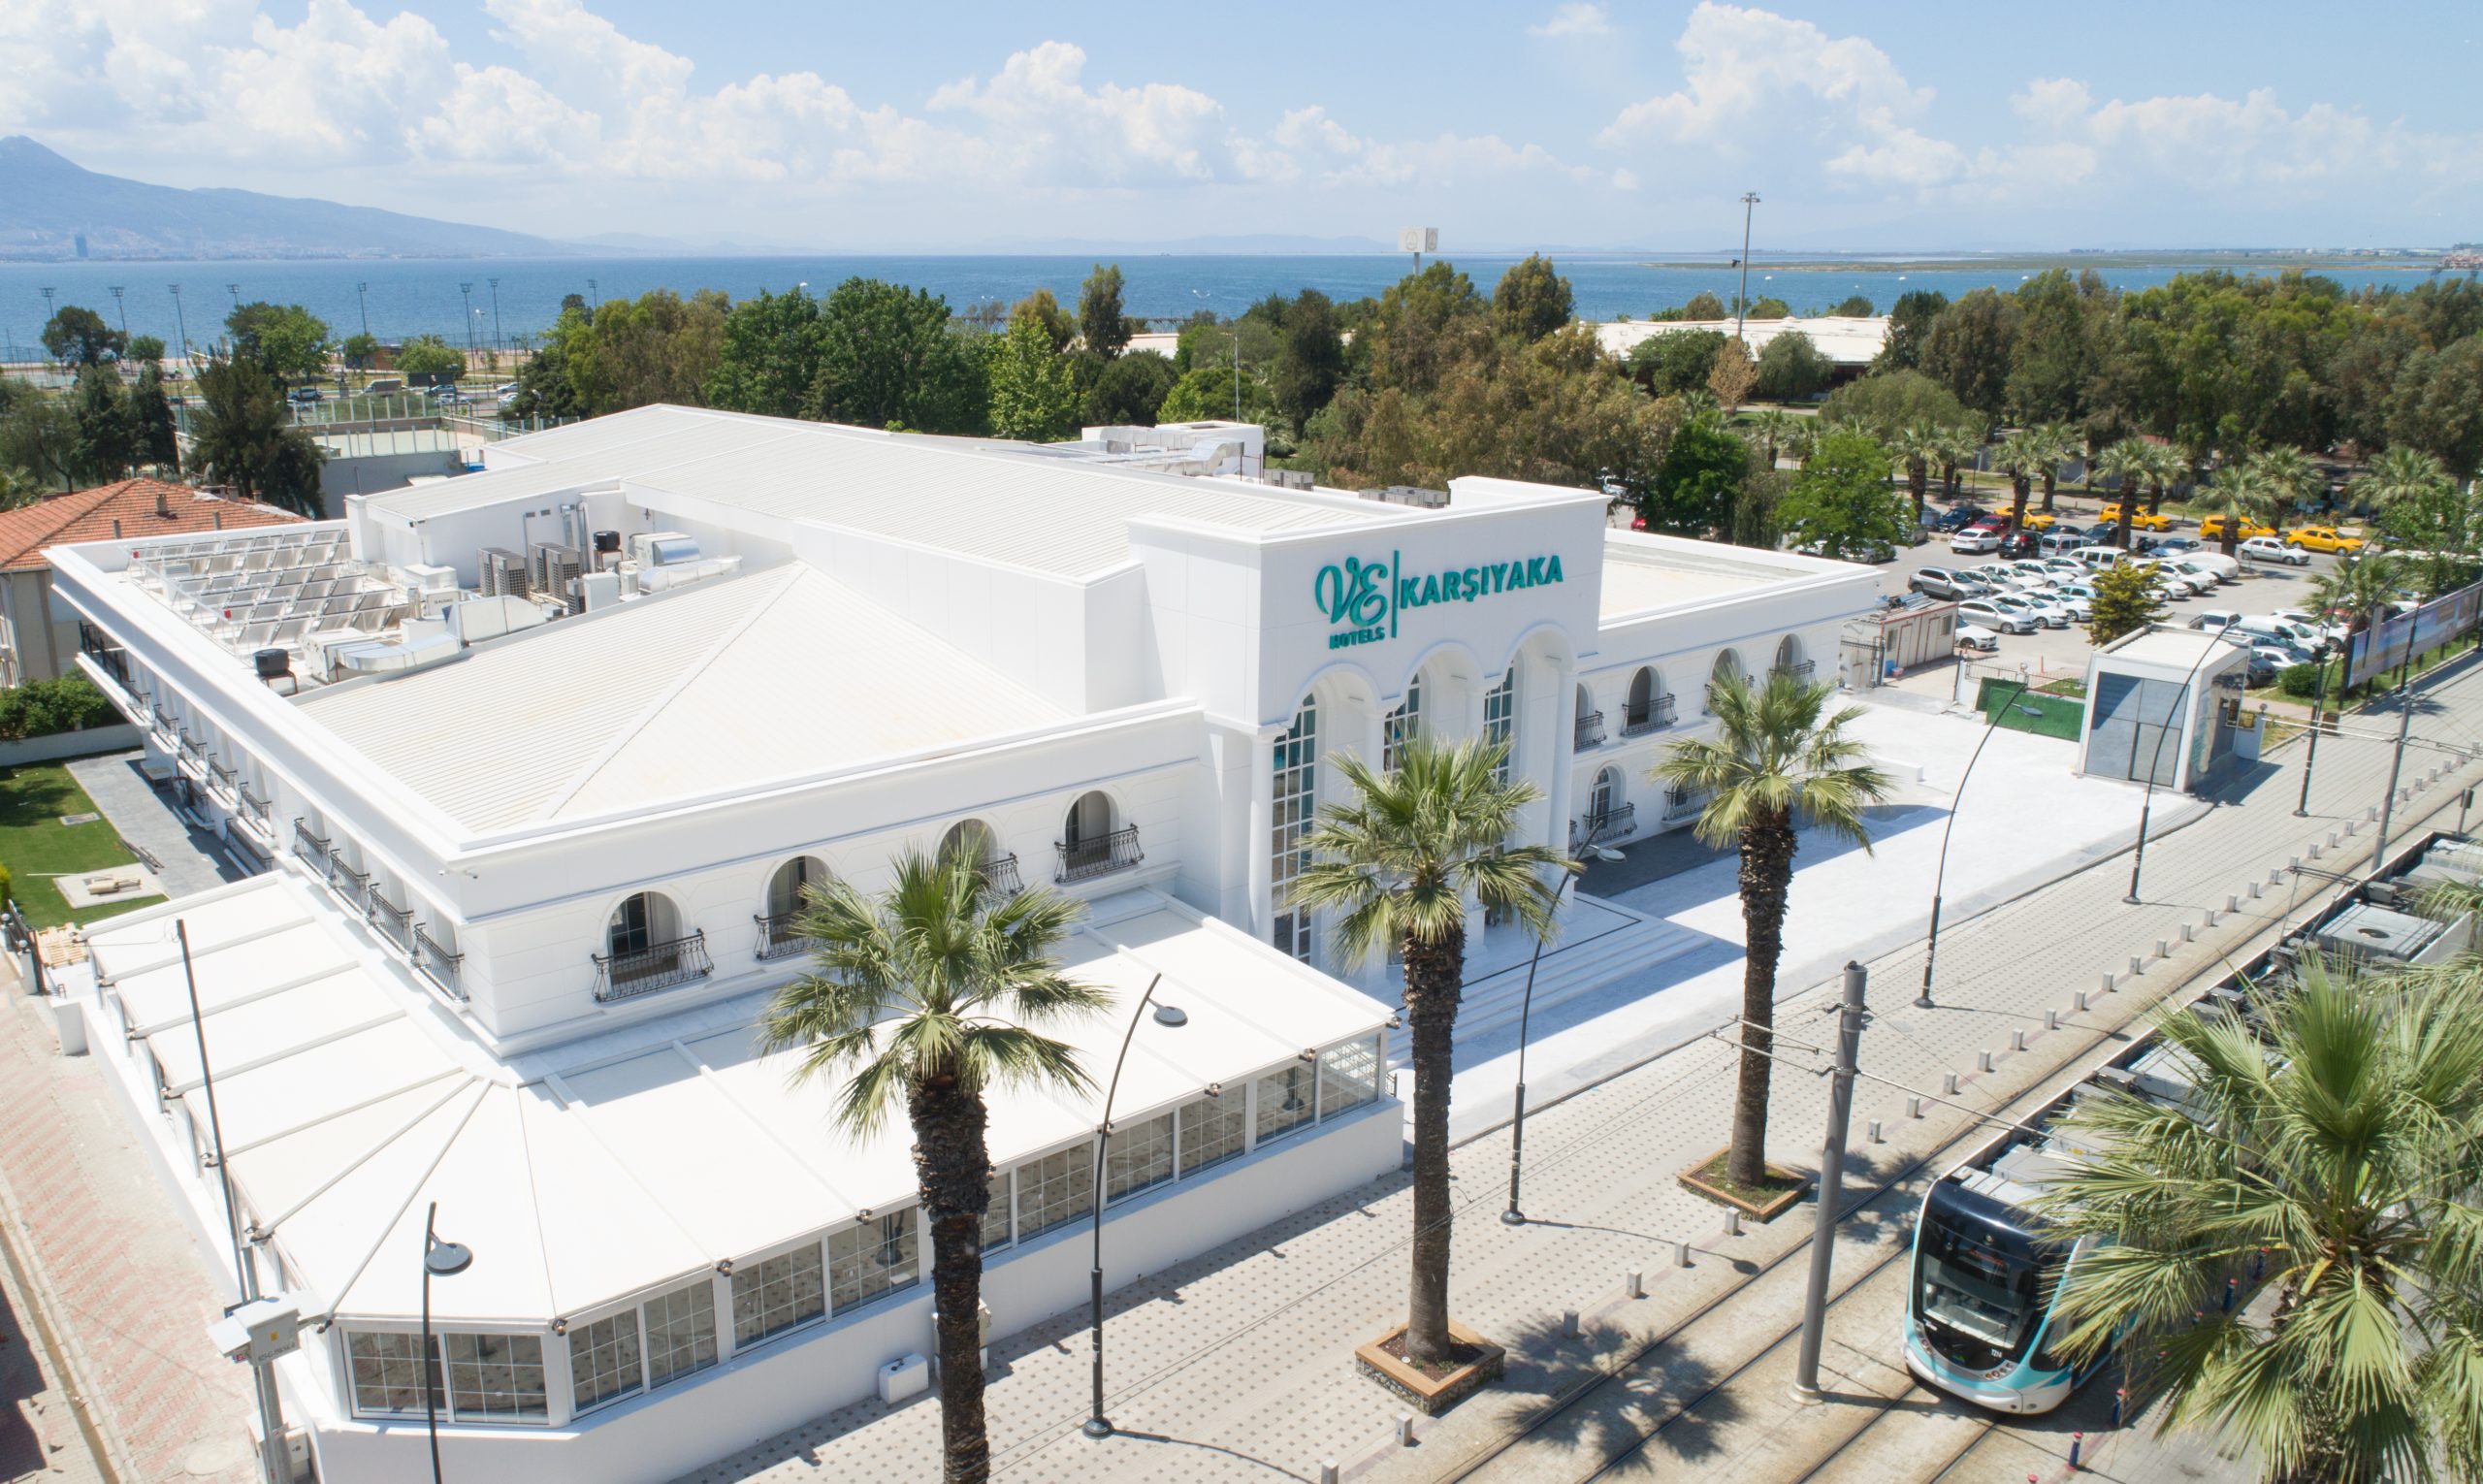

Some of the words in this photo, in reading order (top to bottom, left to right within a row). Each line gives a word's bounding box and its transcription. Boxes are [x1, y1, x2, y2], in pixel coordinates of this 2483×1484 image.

[1315, 557, 1388, 627] VE
[1400, 555, 1564, 609] KARŞIYAKA
[1329, 627, 1385, 650] HOTELS
